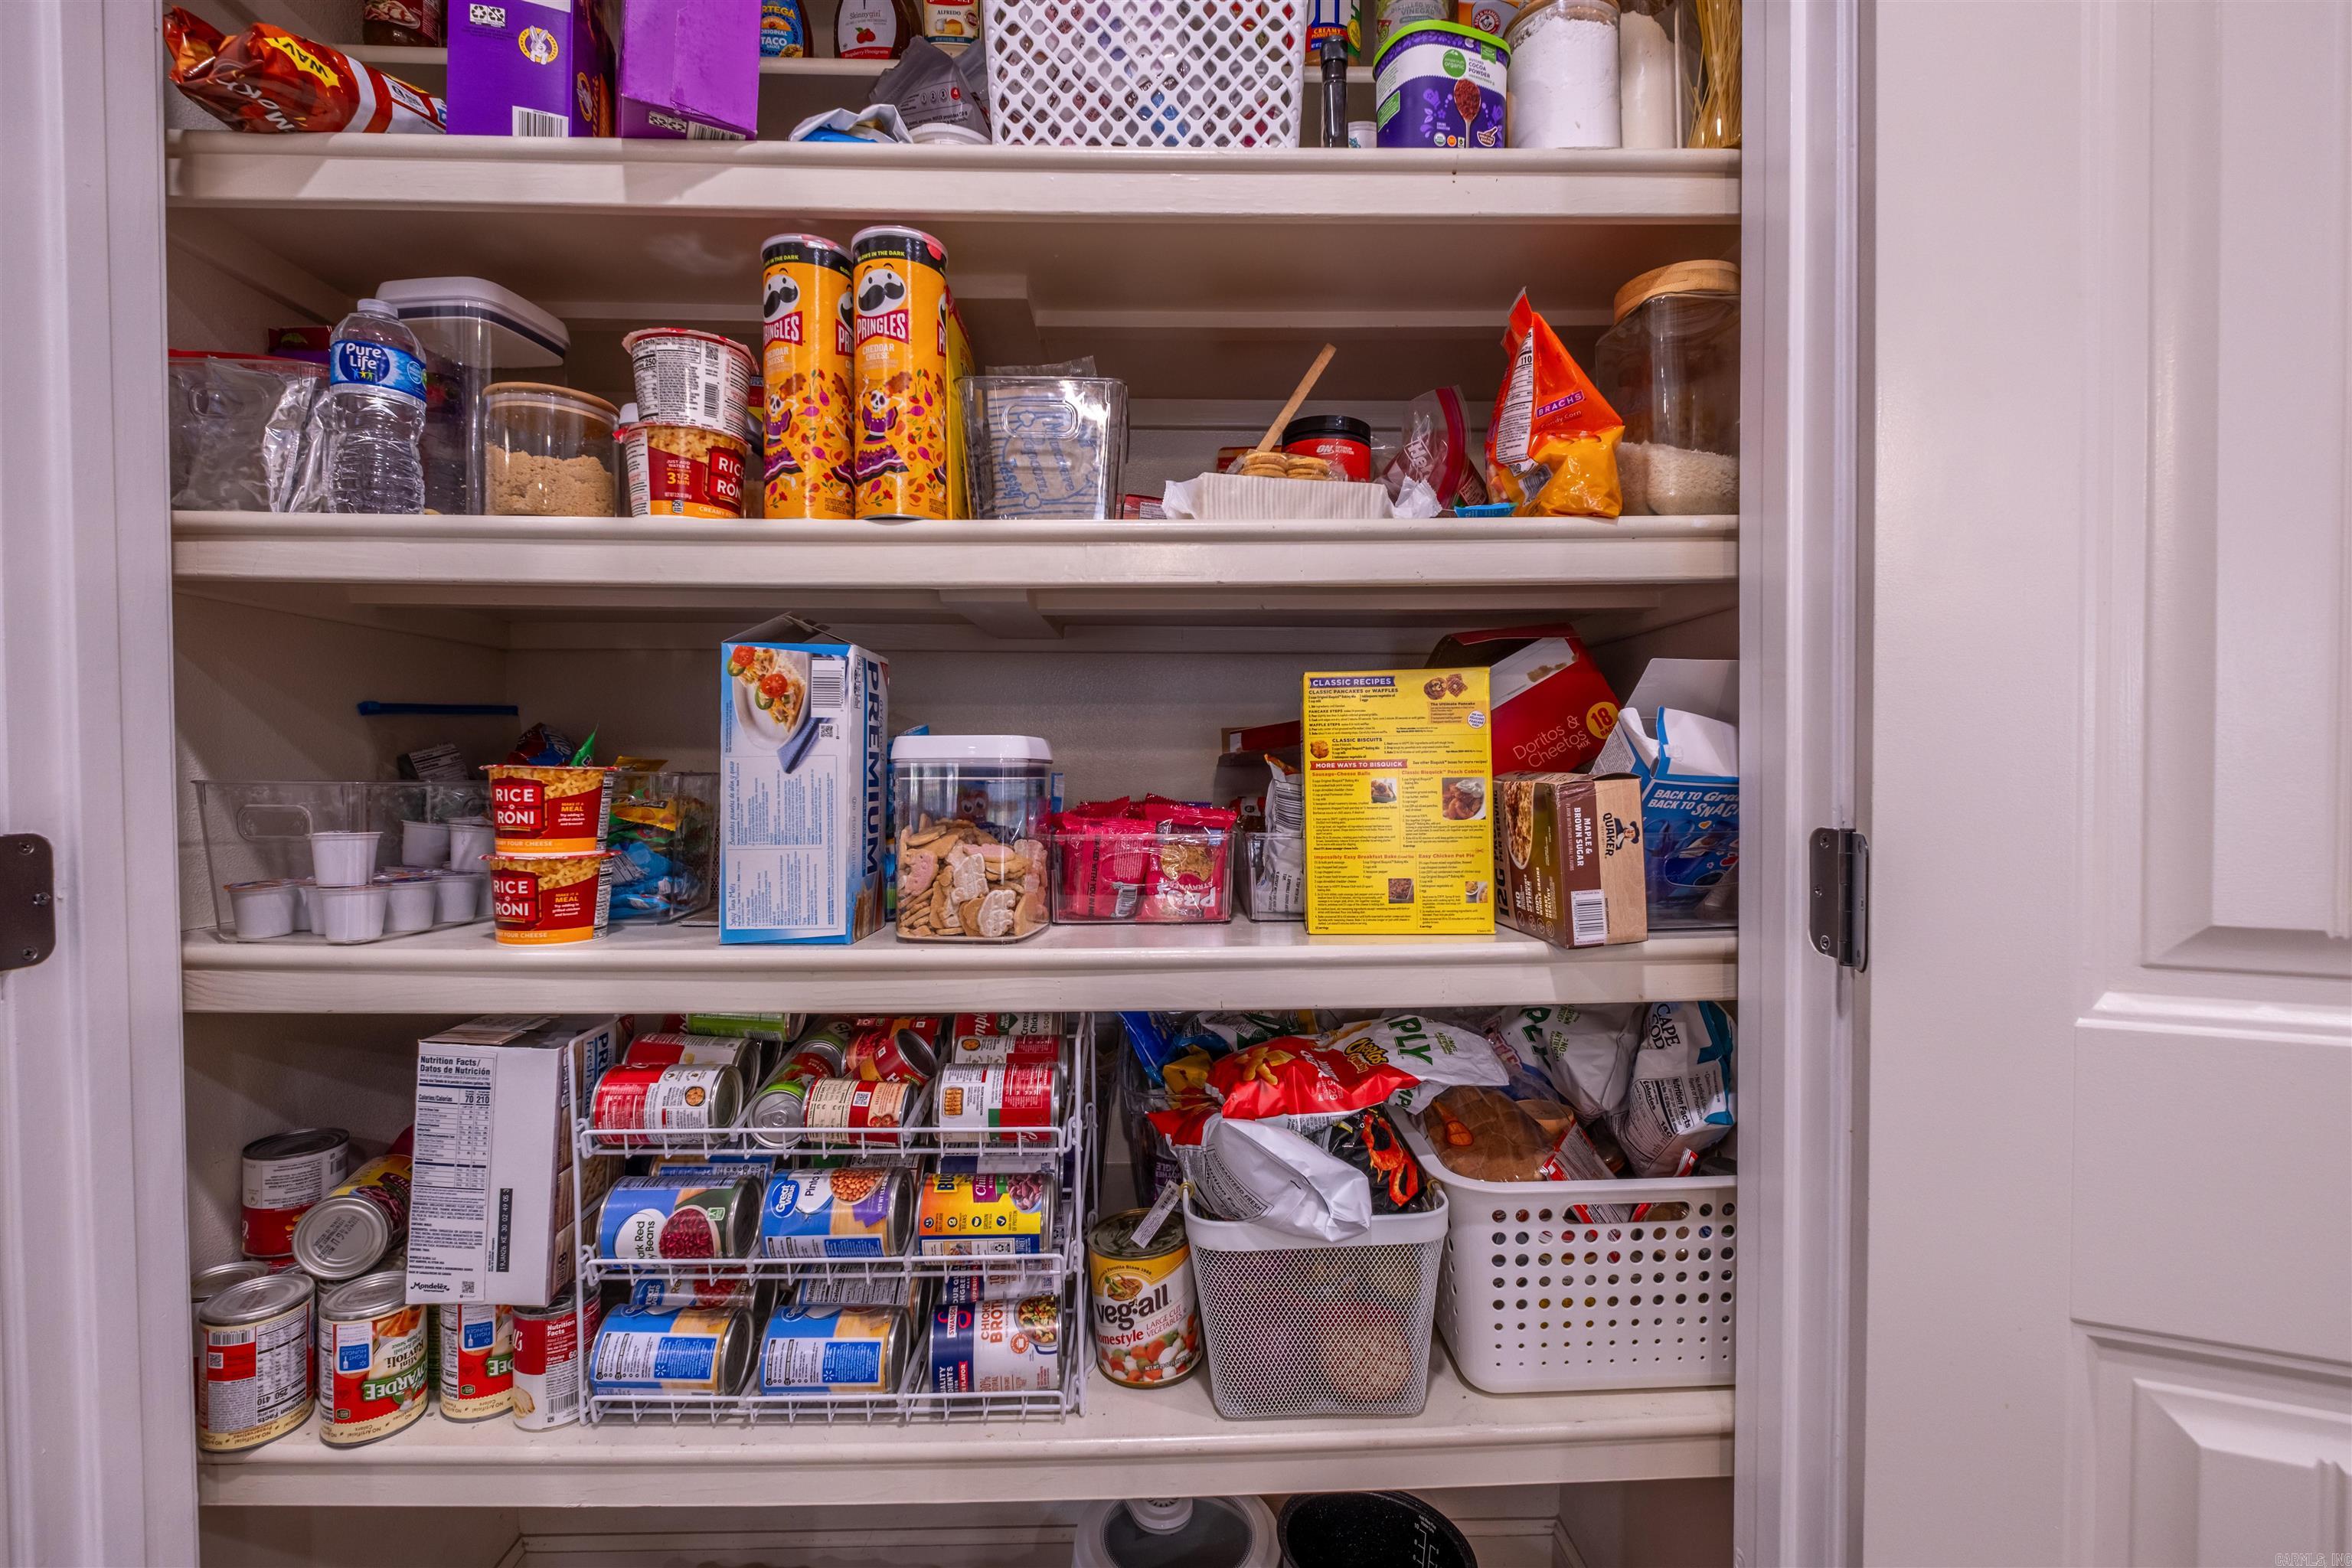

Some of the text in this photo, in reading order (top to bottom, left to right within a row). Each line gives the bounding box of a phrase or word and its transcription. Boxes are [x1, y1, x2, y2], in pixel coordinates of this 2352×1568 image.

[850, 10, 880, 20] Skinnygirl
[761, 37, 787, 46] TACO
[1444, 61, 1464, 70] organic
[1468, 62, 1486, 71] COCOA
[1468, 67, 1491, 78] POWDER
[857, 312, 906, 341] PRINGLES
[346, 342, 381, 358] Pure
[862, 342, 894, 354] CHEDDAR
[865, 351, 890, 361] CHEESE
[350, 354, 377, 371] Life
[645, 358, 657, 367] 250
[1540, 409, 1582, 429] Candy Corn
[1316, 444, 1333, 455] ON
[718, 457, 744, 479] RICE
[667, 472, 677, 485] 3
[717, 479, 741, 498] RON
[1353, 678, 1391, 686] RECIPES
[1590, 708, 1611, 728] 18
[1512, 715, 1581, 760] Doritos &
[1577, 739, 1591, 750] MIX
[1527, 729, 1586, 767] Cheetos
[866, 661, 880, 875] PREMIUM
[1369, 760, 1403, 769] BISQUICK
[495, 788, 534, 803] RICE
[728, 761, 737, 821] picantes queso
[1654, 789, 1702, 800] BACK TO
[1648, 799, 1695, 809] BACK TO
[497, 811, 535, 825] RONI
[1573, 807, 1585, 867] BROWN SUGAR
[1583, 818, 1593, 848] MAPLE
[1602, 812, 1615, 857] QUAKER
[493, 880, 529, 895] RICE
[1495, 869, 1510, 917] 12G
[1515, 891, 1521, 910] NO
[495, 902, 529, 916] RONI
[728, 912, 737, 926] Spicy
[1650, 1016, 1668, 1050] COD
[1656, 1003, 1681, 1047] CAPE
[1344, 1037, 1390, 1066] Cheetos
[420, 1056, 481, 1067] Nutrition Facts/
[586, 1040, 595, 1080] Fresh
[420, 1063, 491, 1076] Datos de Nutrición
[465, 1094, 491, 1105] 70 210
[1644, 1080, 1657, 1112] Calories
[1673, 1077, 1692, 1129] Nutrition Facts
[1660, 1119, 1674, 1138] 140
[805, 1176, 820, 1197] Pinto
[975, 1174, 987, 1196] Chili
[1212, 1152, 1263, 1212] GUARANTEED FRESH
[775, 1184, 790, 1213] Great
[783, 1184, 795, 1206] Value
[635, 1220, 645, 1241] Red
[645, 1220, 655, 1252] Beans
[499, 1224, 509, 1270] 19JAN26 30
[547, 1319, 576, 1332] Nutrition
[990, 1299, 1004, 1344] BROTH
[1145, 1304, 1182, 1331] LARGE CUT
[1146, 1311, 1183, 1338] VEGETABLES
[466, 1326, 492, 1335] HUNGER
[547, 1328, 565, 1338] Facts
[1096, 1329, 1144, 1348] Homestyle
[341, 1348, 368, 1357] HUNGER
[546, 1354, 565, 1363] Calories
[568, 1350, 578, 1361] 60
[399, 1354, 418, 1370] Mini
[365, 1368, 428, 1401] OYARDEE
[257, 1396, 271, 1406] 410
[275, 1387, 288, 1400] 250
[472, 1404, 495, 1413] Artificial
[257, 1412, 279, 1424] Facts
[347, 1428, 372, 1439] Artificial
[354, 1423, 374, 1432] Colors
[234, 1433, 261, 1446] Artificial
